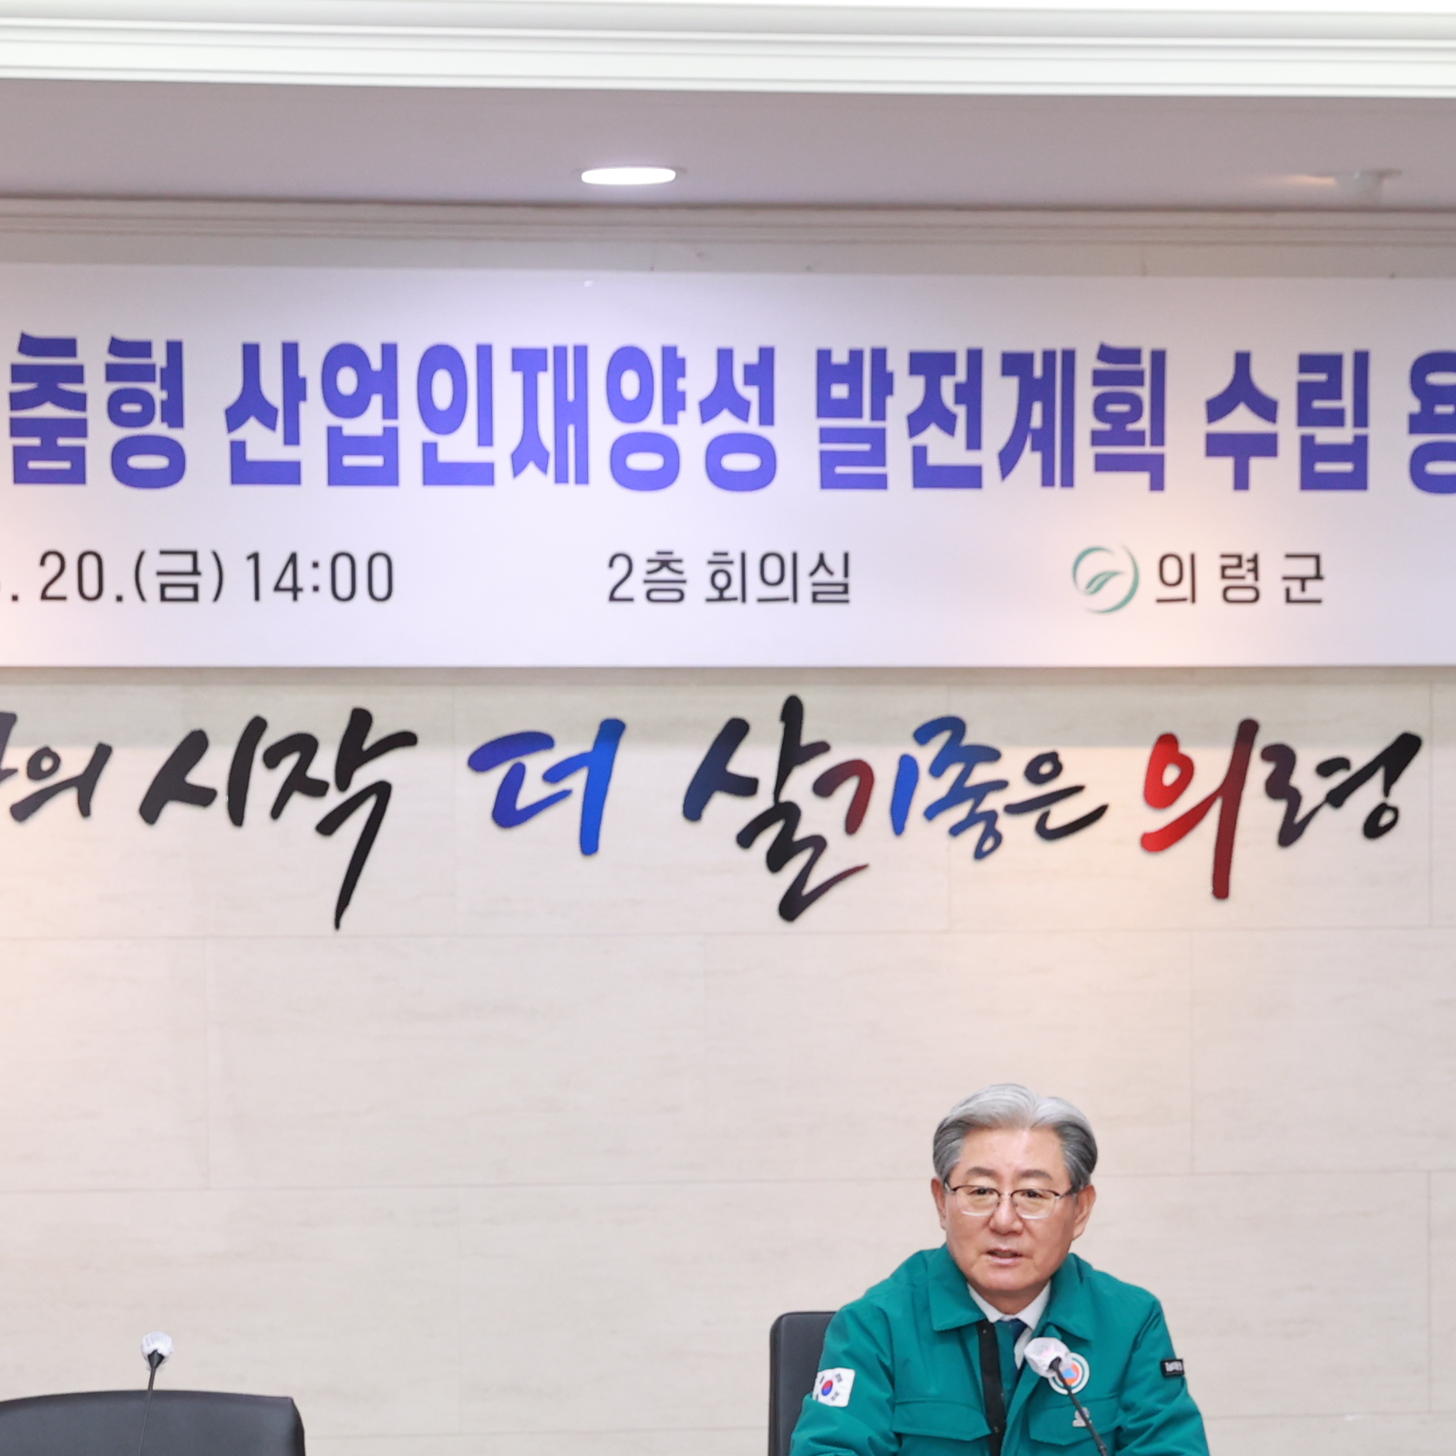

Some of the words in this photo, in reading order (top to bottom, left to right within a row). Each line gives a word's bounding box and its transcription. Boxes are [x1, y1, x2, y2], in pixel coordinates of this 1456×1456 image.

[225, 342, 777, 491] 산업인재양성
[816, 345, 1166, 491] 발전계획
[1206, 352, 1369, 491] 수립
[246, 552, 393, 602] 14:00
[610, 551, 687, 603] 2층
[706, 552, 849, 603] 회의실
[138, 707, 418, 930] 시작
[467, 718, 626, 856] 더
[682, 694, 1109, 923] 살기좋은
[1140, 718, 1423, 900] 의령
